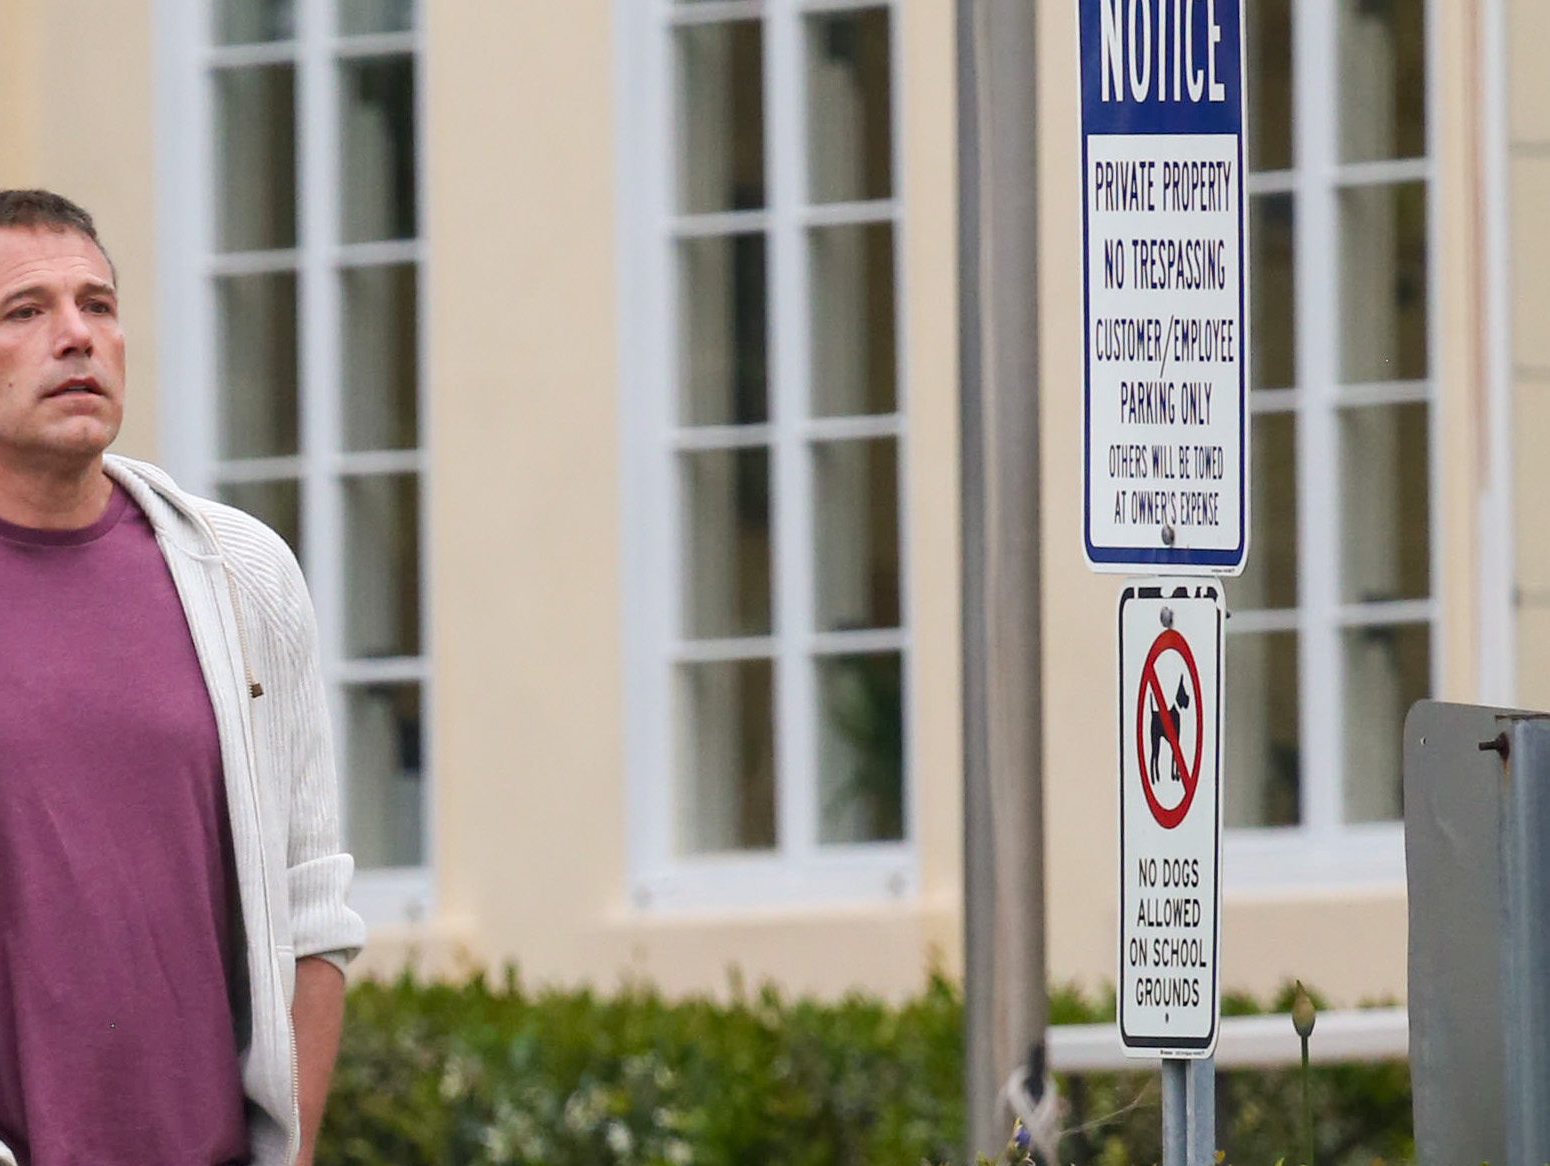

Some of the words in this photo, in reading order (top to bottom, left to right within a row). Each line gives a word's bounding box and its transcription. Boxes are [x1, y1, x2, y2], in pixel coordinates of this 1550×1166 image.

[1100, 0, 1225, 103] NOTICE
[1095, 160, 1156, 212] PRIVATE
[1163, 160, 1232, 212] PROPERTY
[1104, 238, 1125, 290] NO
[1131, 238, 1226, 291] TRESPASSING
[1095, 314, 1235, 378] CUSTOMER/EMPLOYEE
[1120, 381, 1175, 425] PARKING
[1181, 382, 1212, 426] ONLY
[1108, 444, 1148, 479] OTHERS
[1151, 445, 1176, 480] WILL
[1178, 445, 1191, 480] BE
[1193, 445, 1224, 481] TOWED
[1114, 490, 1127, 524] AT
[1131, 490, 1177, 525] OWNER'S
[1180, 491, 1219, 527] EXPENSE
[1138, 858, 1157, 888] NO
[1162, 858, 1200, 888] DOGS
[1136, 898, 1201, 928] ALLOWED
[1129, 937, 1148, 967] ON
[1152, 937, 1207, 968] SCHOOL
[1135, 977, 1200, 1008] GROUNDS
